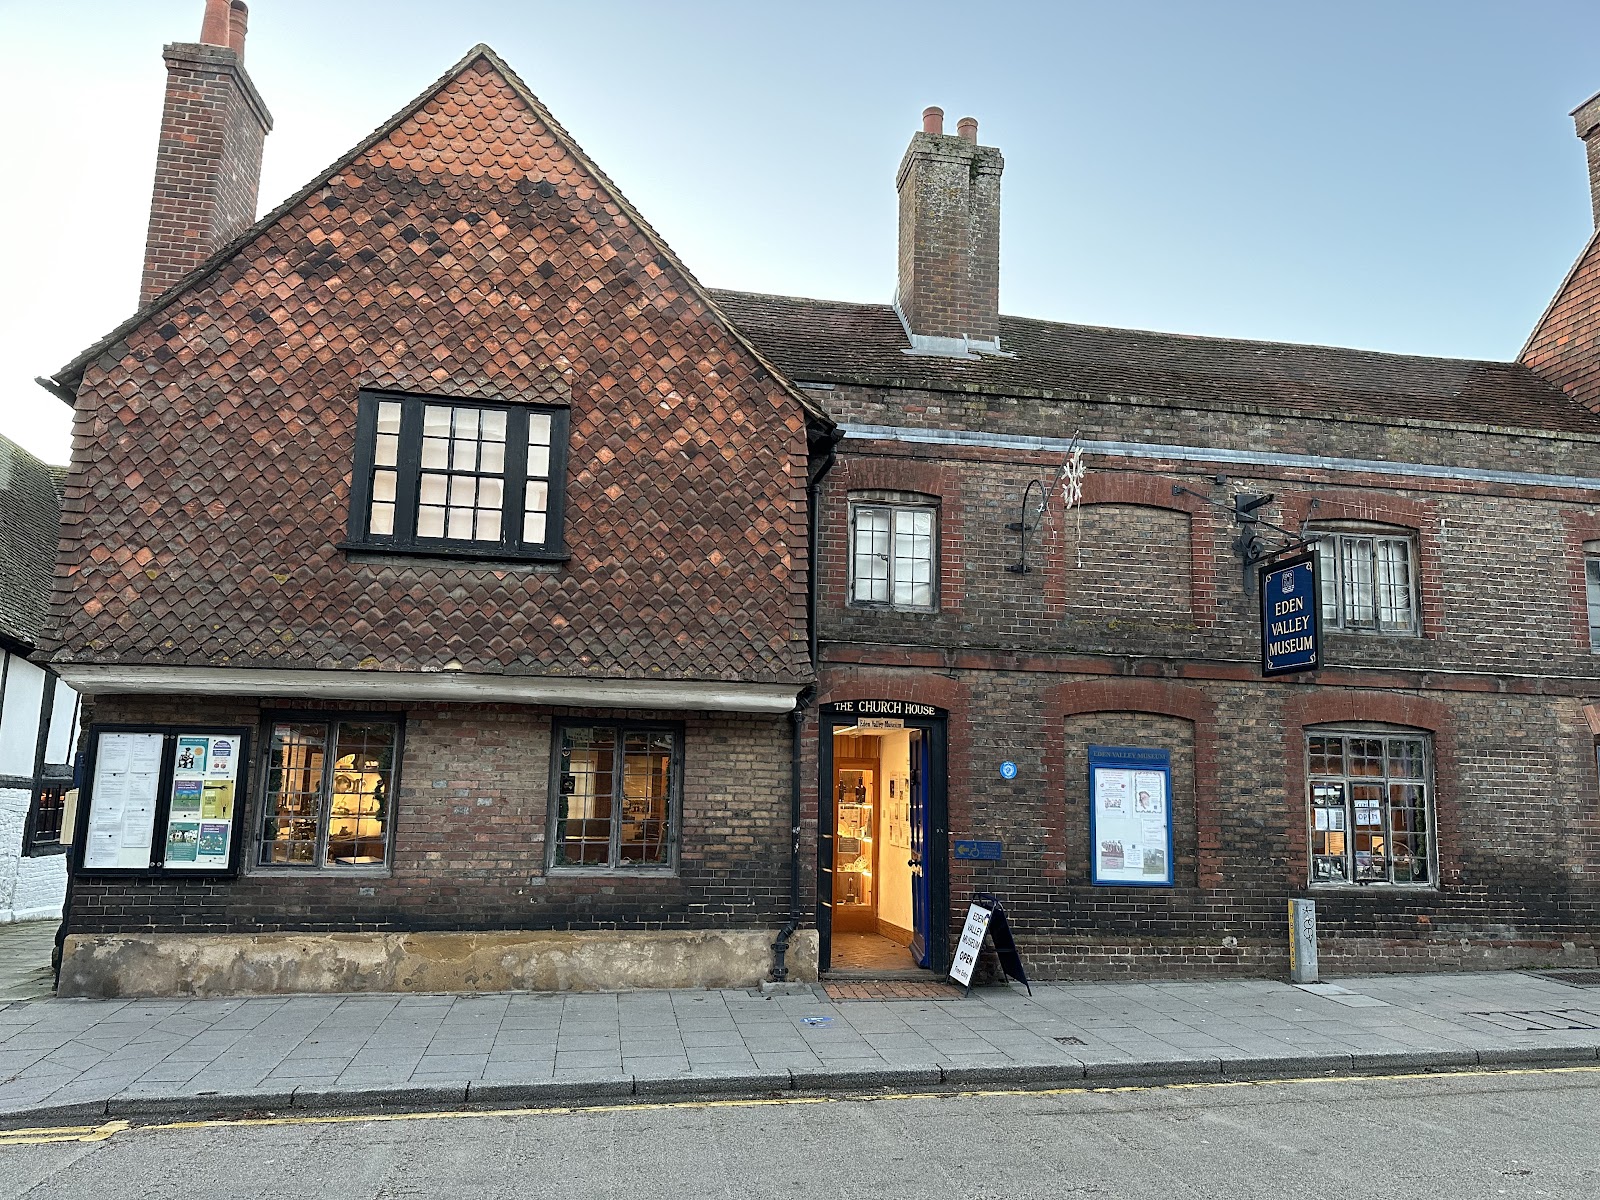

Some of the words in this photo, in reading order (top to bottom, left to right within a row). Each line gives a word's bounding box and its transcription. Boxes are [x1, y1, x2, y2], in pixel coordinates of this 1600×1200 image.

[1275, 596, 1303, 616] EDEN
[1271, 615, 1310, 636] VALLEY
[1269, 635, 1313, 657] MUSEUM
[834, 701, 854, 711] THE
[858, 700, 902, 714] CHURCH
[904, 703, 936, 715] HOUSE
[972, 911, 984, 923] EDEN
[967, 923, 983, 938] VALLEY
[962, 934, 981, 950] MUSEUM
[959, 950, 974, 966] OPEN
